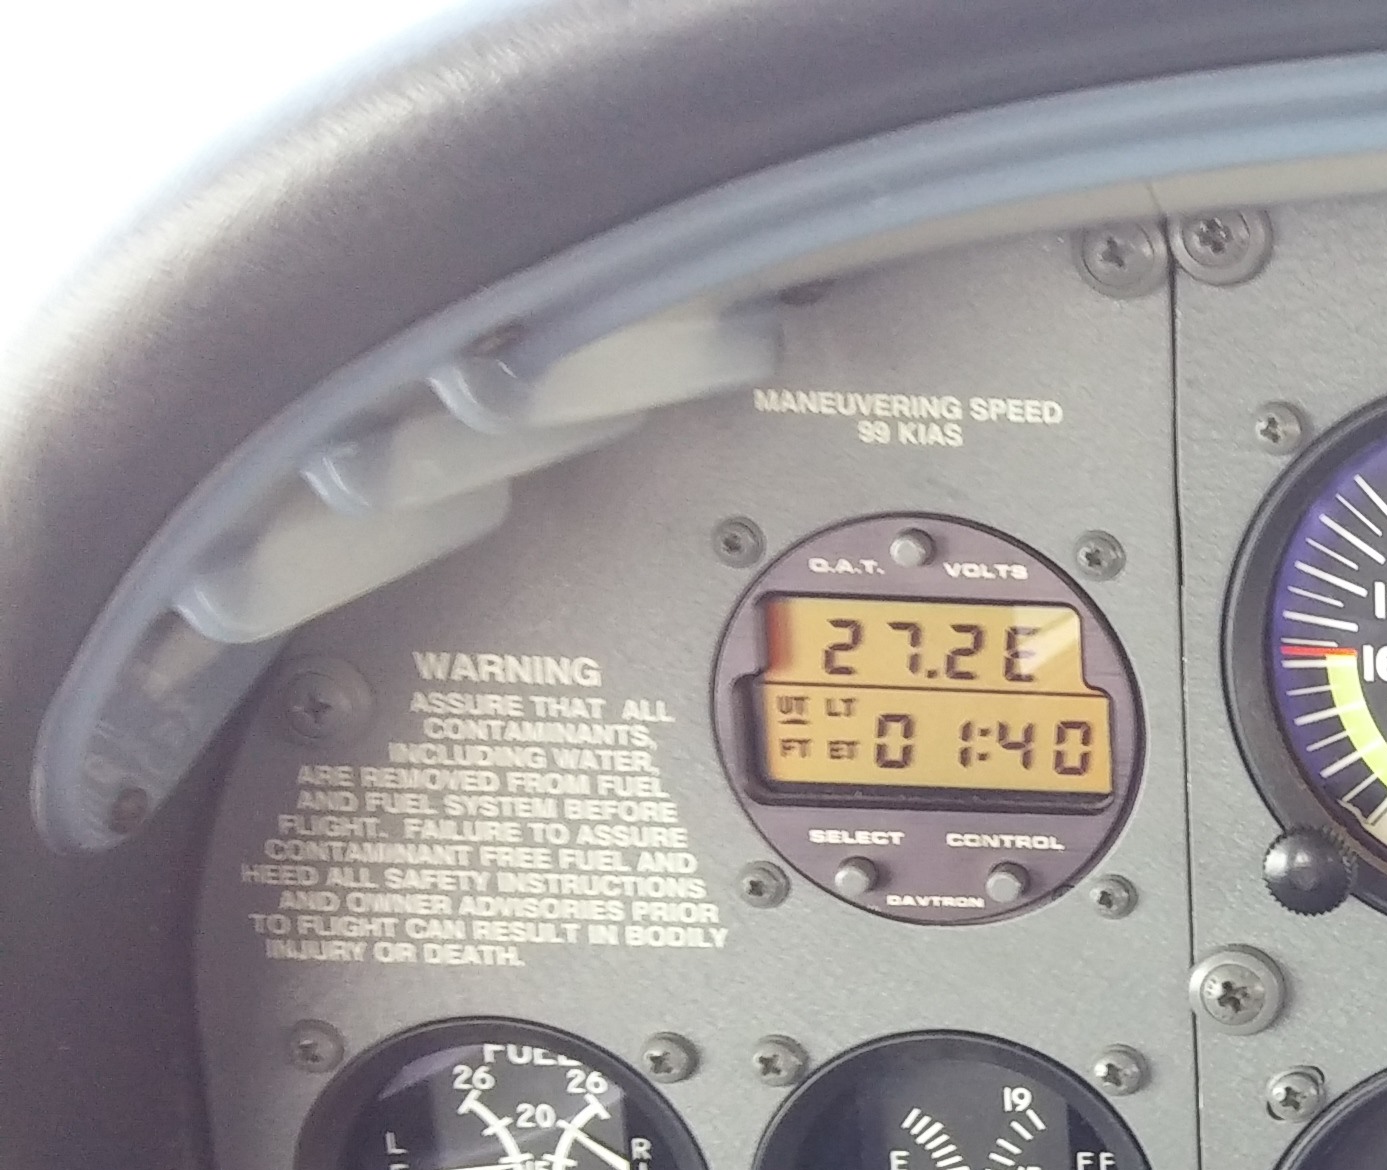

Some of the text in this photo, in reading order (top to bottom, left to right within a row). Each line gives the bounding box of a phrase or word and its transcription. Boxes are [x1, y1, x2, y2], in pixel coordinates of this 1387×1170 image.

[753, 388, 1064, 425] MANEUVERING SPEED
[857, 420, 964, 448] 99 KIAS
[943, 562, 1029, 580] VOLTS
[413, 650, 603, 687] WARNING
[809, 829, 905, 846] SELECT
[946, 833, 1065, 851] CONTROL
[887, 895, 985, 908] DAVTRON
[452, 1065, 496, 1090] 26
[567, 1068, 609, 1095] 26
[1002, 1086, 1033, 1112] 19
[516, 1104, 557, 1128] 20
